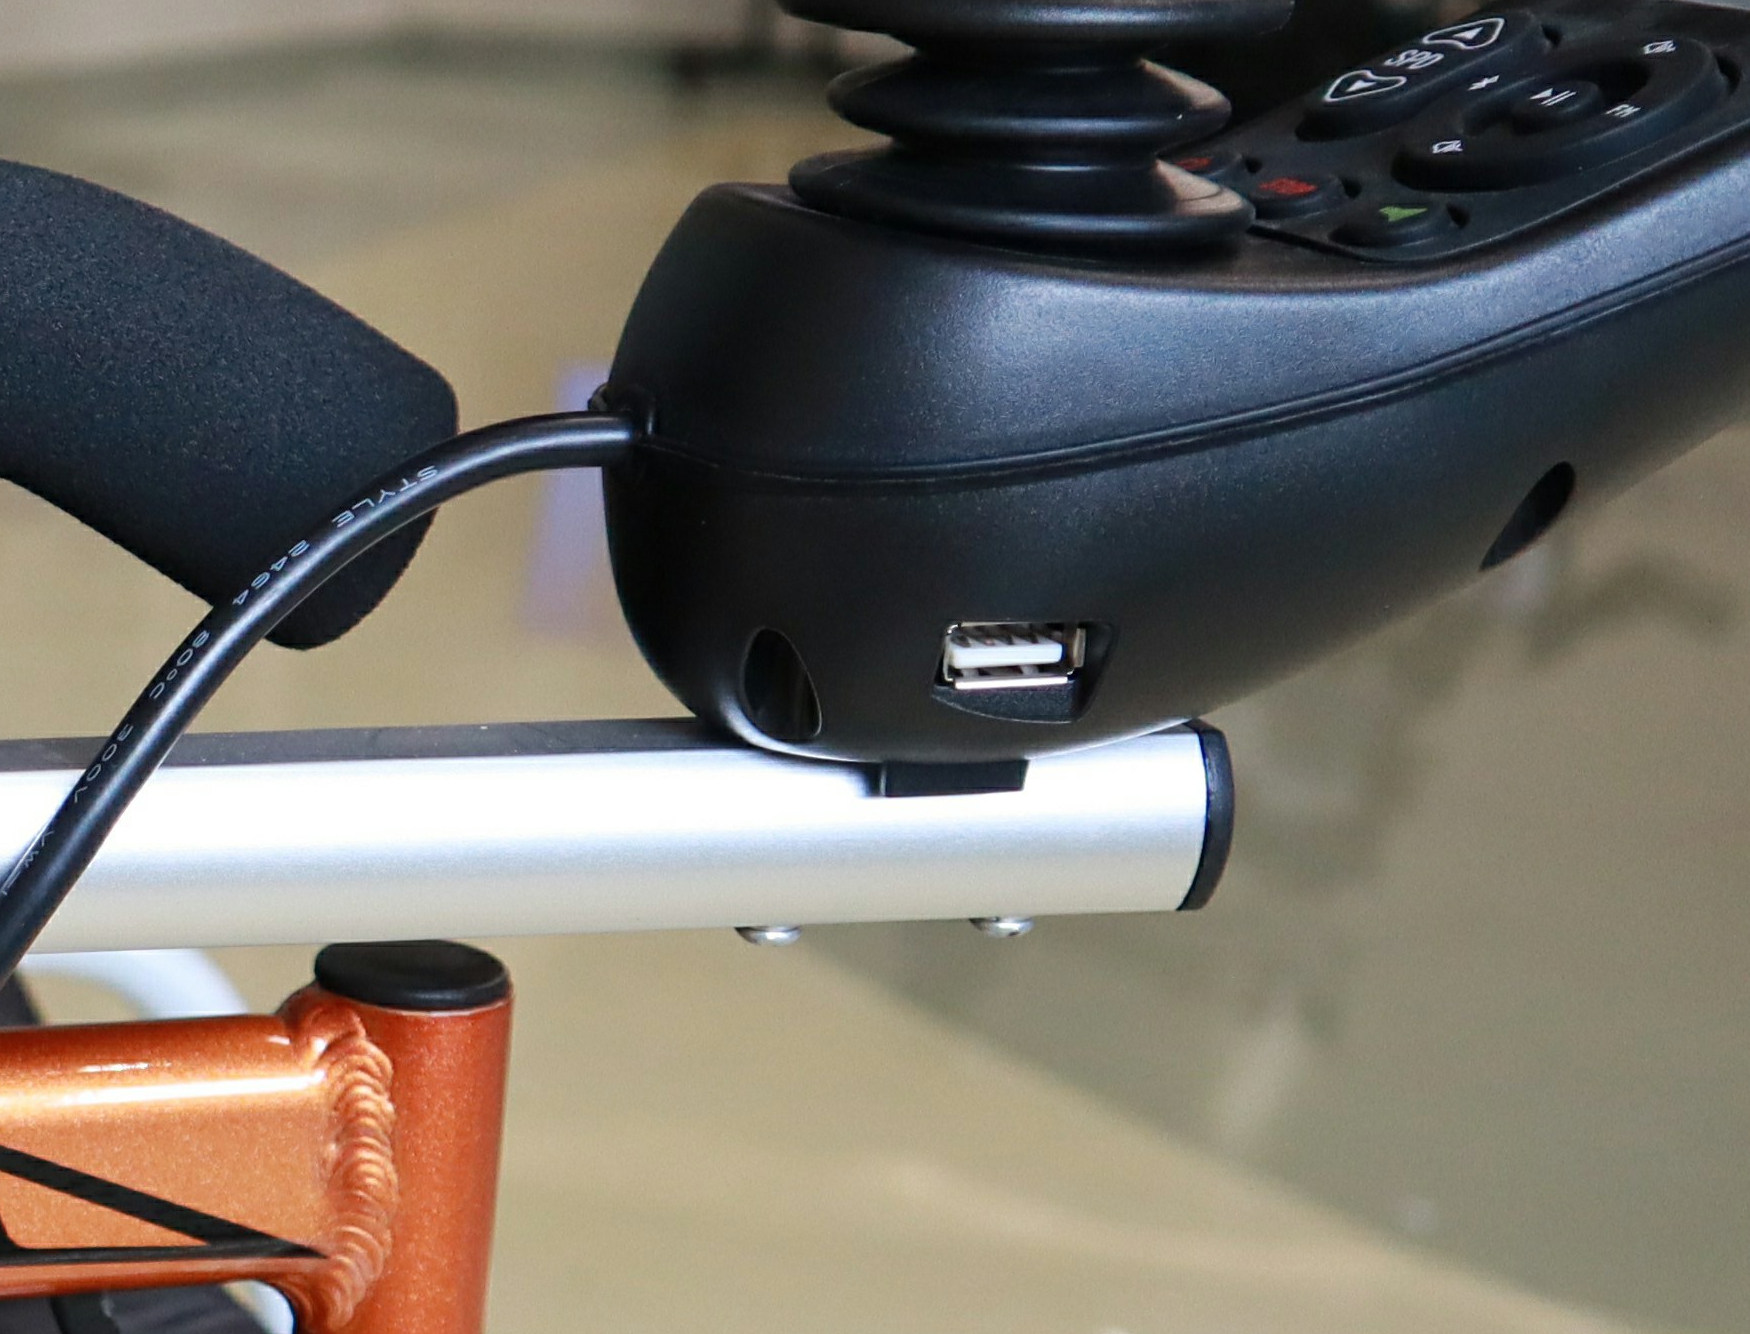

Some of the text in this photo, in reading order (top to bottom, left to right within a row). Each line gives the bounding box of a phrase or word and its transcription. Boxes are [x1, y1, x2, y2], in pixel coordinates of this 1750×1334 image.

[1604, 103, 1642, 119] FM
[331, 465, 439, 528] STYLE
[232, 539, 310, 606] 2464
[73, 723, 134, 804] 300V
